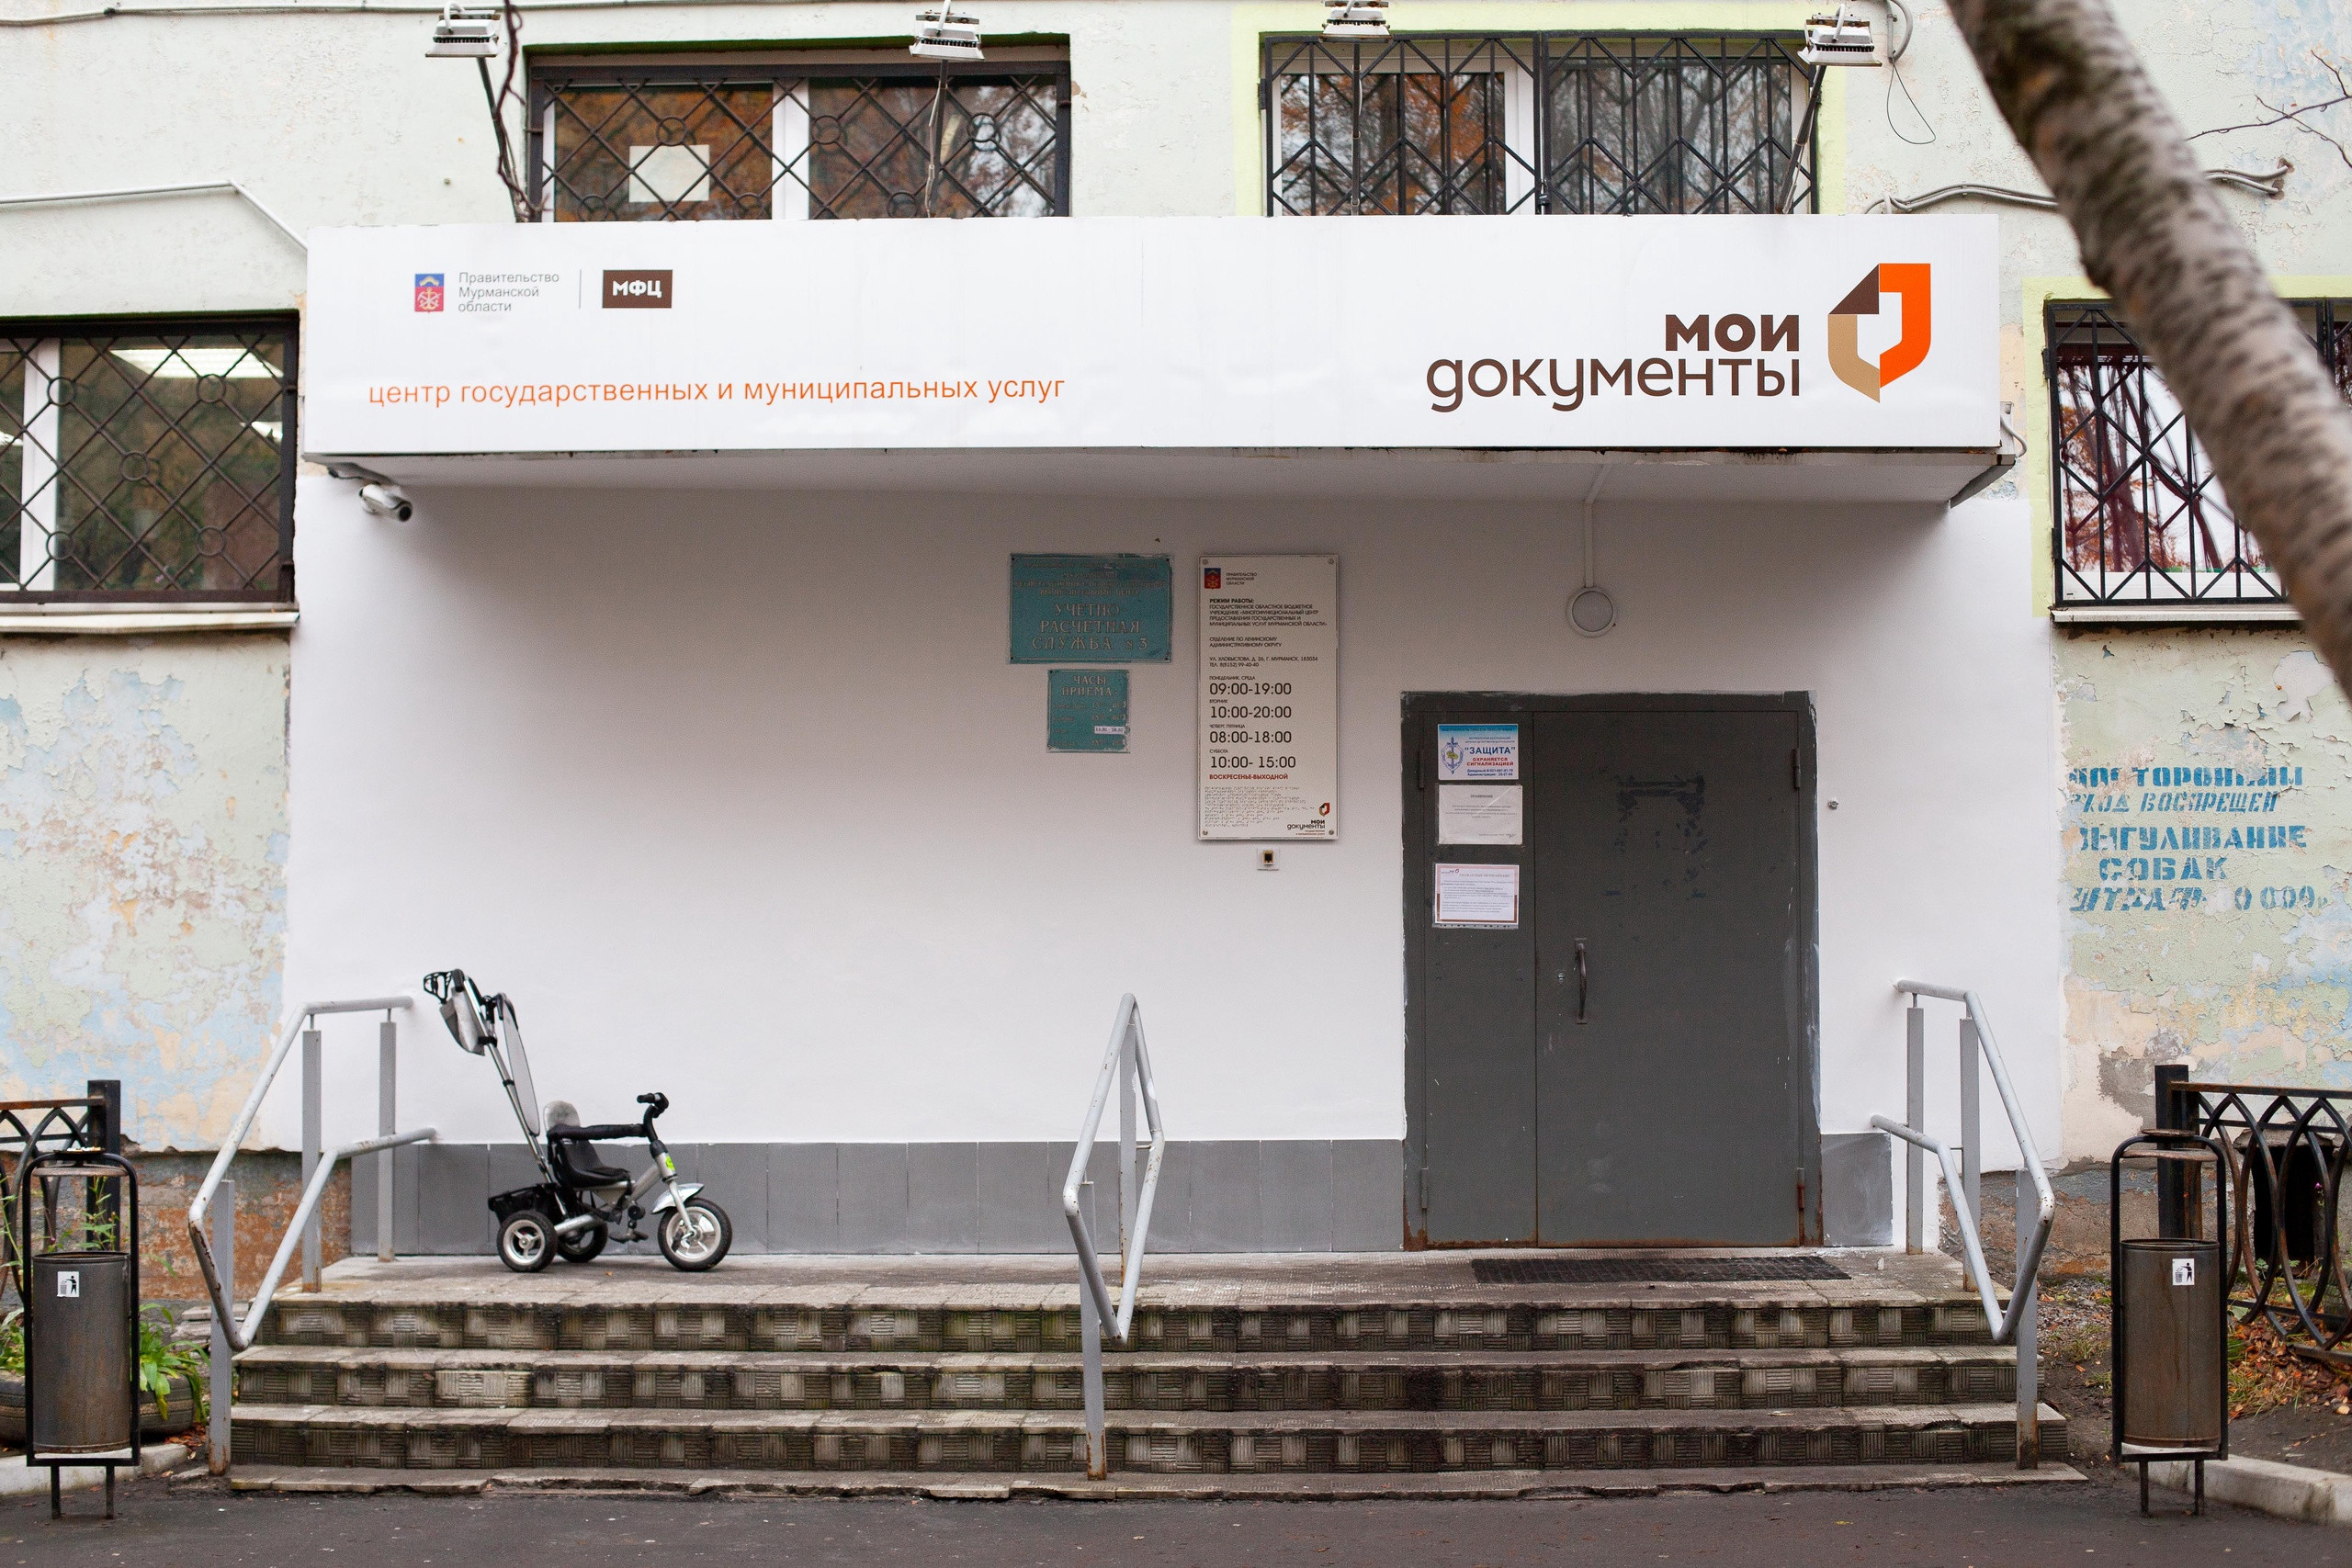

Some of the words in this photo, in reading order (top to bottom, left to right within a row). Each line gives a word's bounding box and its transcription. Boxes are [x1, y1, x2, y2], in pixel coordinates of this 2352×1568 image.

[458, 272, 560, 286] Правительство
[458, 286, 539, 299] Мурманской
[612, 279, 663, 299] МФЦ
[458, 299, 513, 312] области
[1665, 313, 1800, 353] мои
[1426, 357, 1800, 413] документы
[368, 385, 451, 407] центр
[460, 382, 708, 408] государственных
[717, 382, 733, 400] и
[743, 379, 978, 406] муниципальных
[988, 378, 1066, 404] услуг
[1040, 620, 1141, 634] РАСЧЕТНАЯ
[1032, 637, 1113, 650] СЛУЖБА
[1138, 637, 1148, 650] 3
[1073, 675, 1107, 685] ЧАСЫ
[1209, 682, 1292, 695] 09:00-19:00
[1210, 705, 1292, 718] 10:00-20:00
[1209, 730, 1292, 743] 08:00-18:00
[2099, 856, 2228, 881] СОБАК
